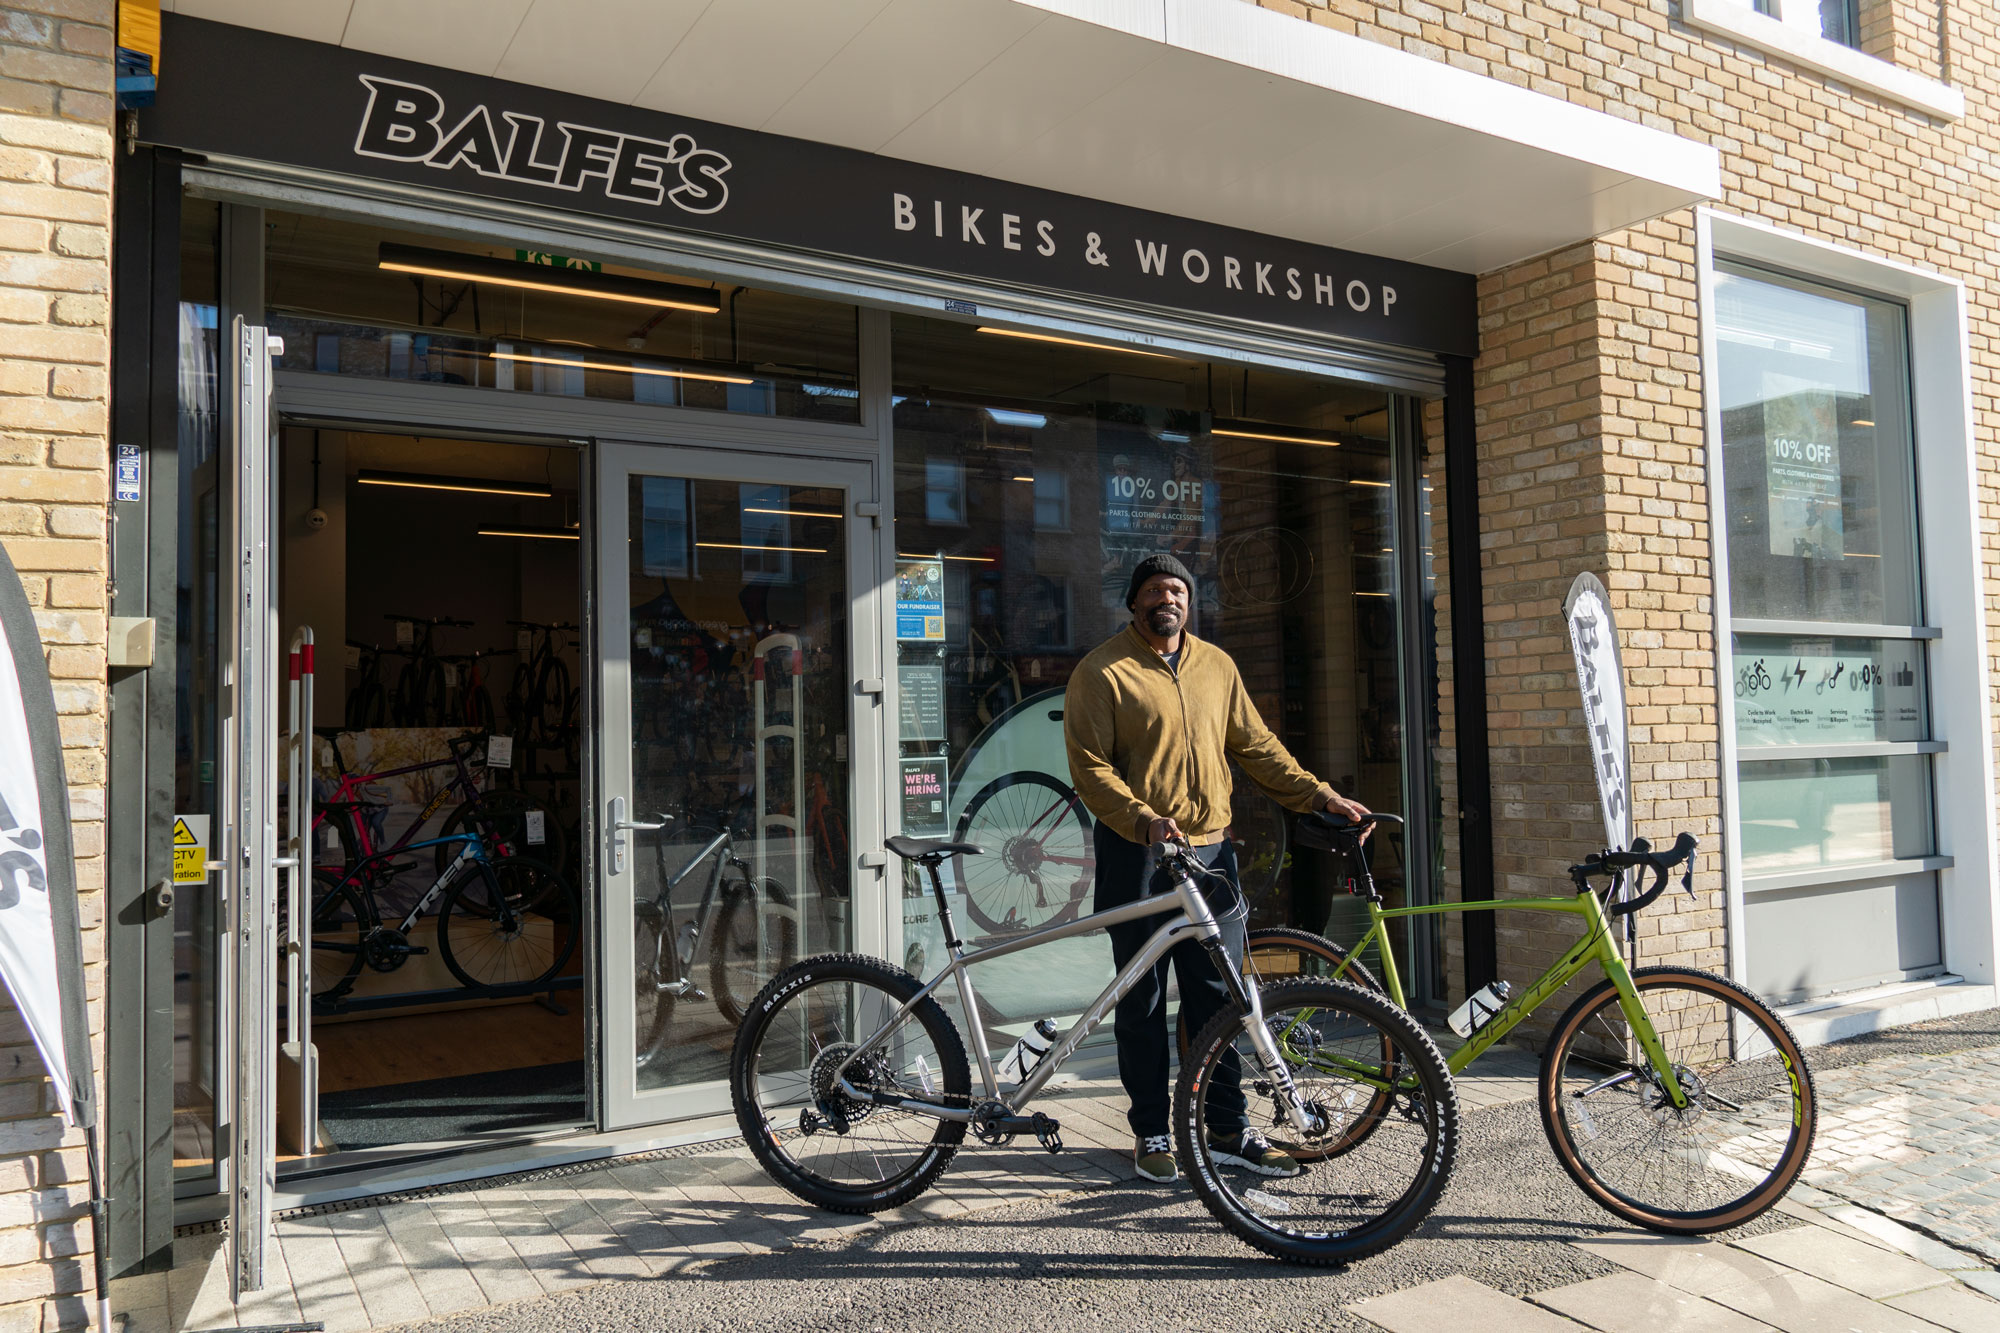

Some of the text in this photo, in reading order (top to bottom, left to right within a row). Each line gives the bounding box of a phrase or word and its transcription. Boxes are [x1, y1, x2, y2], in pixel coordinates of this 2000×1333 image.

[355, 74, 732, 214] BALFE'S
[893, 192, 1398, 316] BIKES & WORKSHOP
[122, 446, 136, 455] 24
[1774, 438, 1831, 464] 10% OFF
[1112, 476, 1201, 502] 10% OFF
[1131, 510, 1161, 519] CLOTHING
[1168, 514, 1205, 522] ACCESSORIES
[1863, 664, 1882, 685] 0%
[905, 774, 936, 784] WE'RE
[905, 784, 941, 795] HIRING
[400, 842, 477, 934] TREK
[762, 974, 812, 1013] MAXXIS
[1470, 961, 1568, 1052] WHYTE
[1431, 1100, 1446, 1175] MAXXIS
